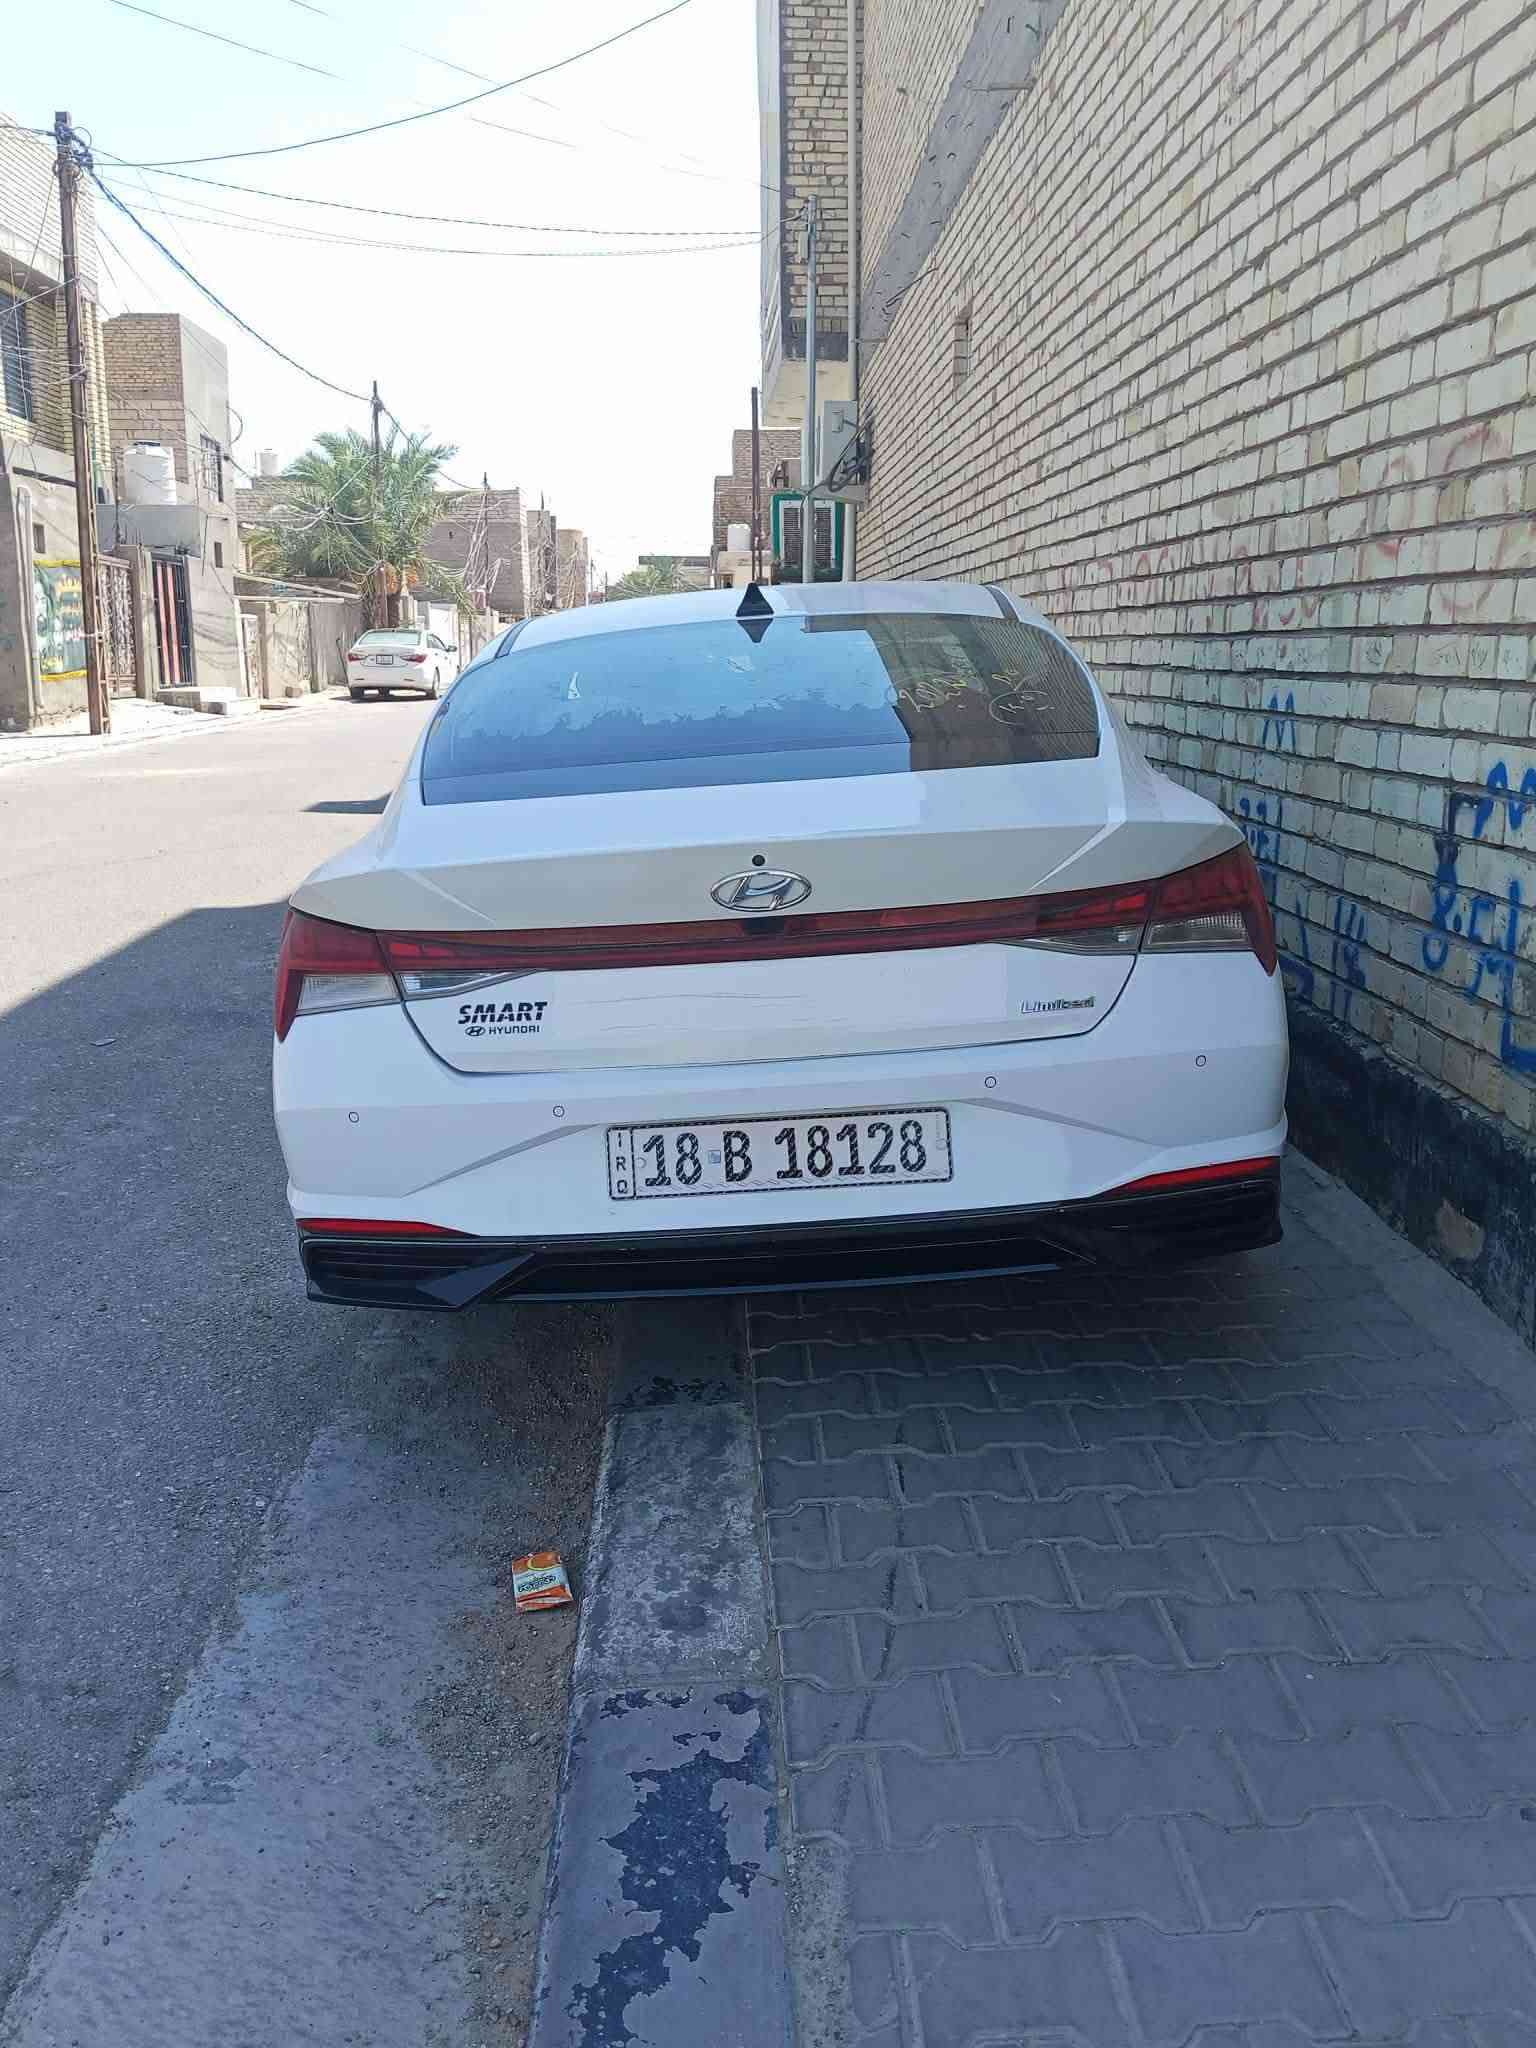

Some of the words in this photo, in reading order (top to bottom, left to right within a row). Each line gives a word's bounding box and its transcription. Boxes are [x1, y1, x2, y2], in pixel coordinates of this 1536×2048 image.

[458, 1001, 548, 1024] SMART
[488, 1025, 540, 1035] HYUNDAI
[642, 1132, 703, 1187] 18
[723, 1130, 753, 1182] B
[774, 1119, 927, 1180] 18128
